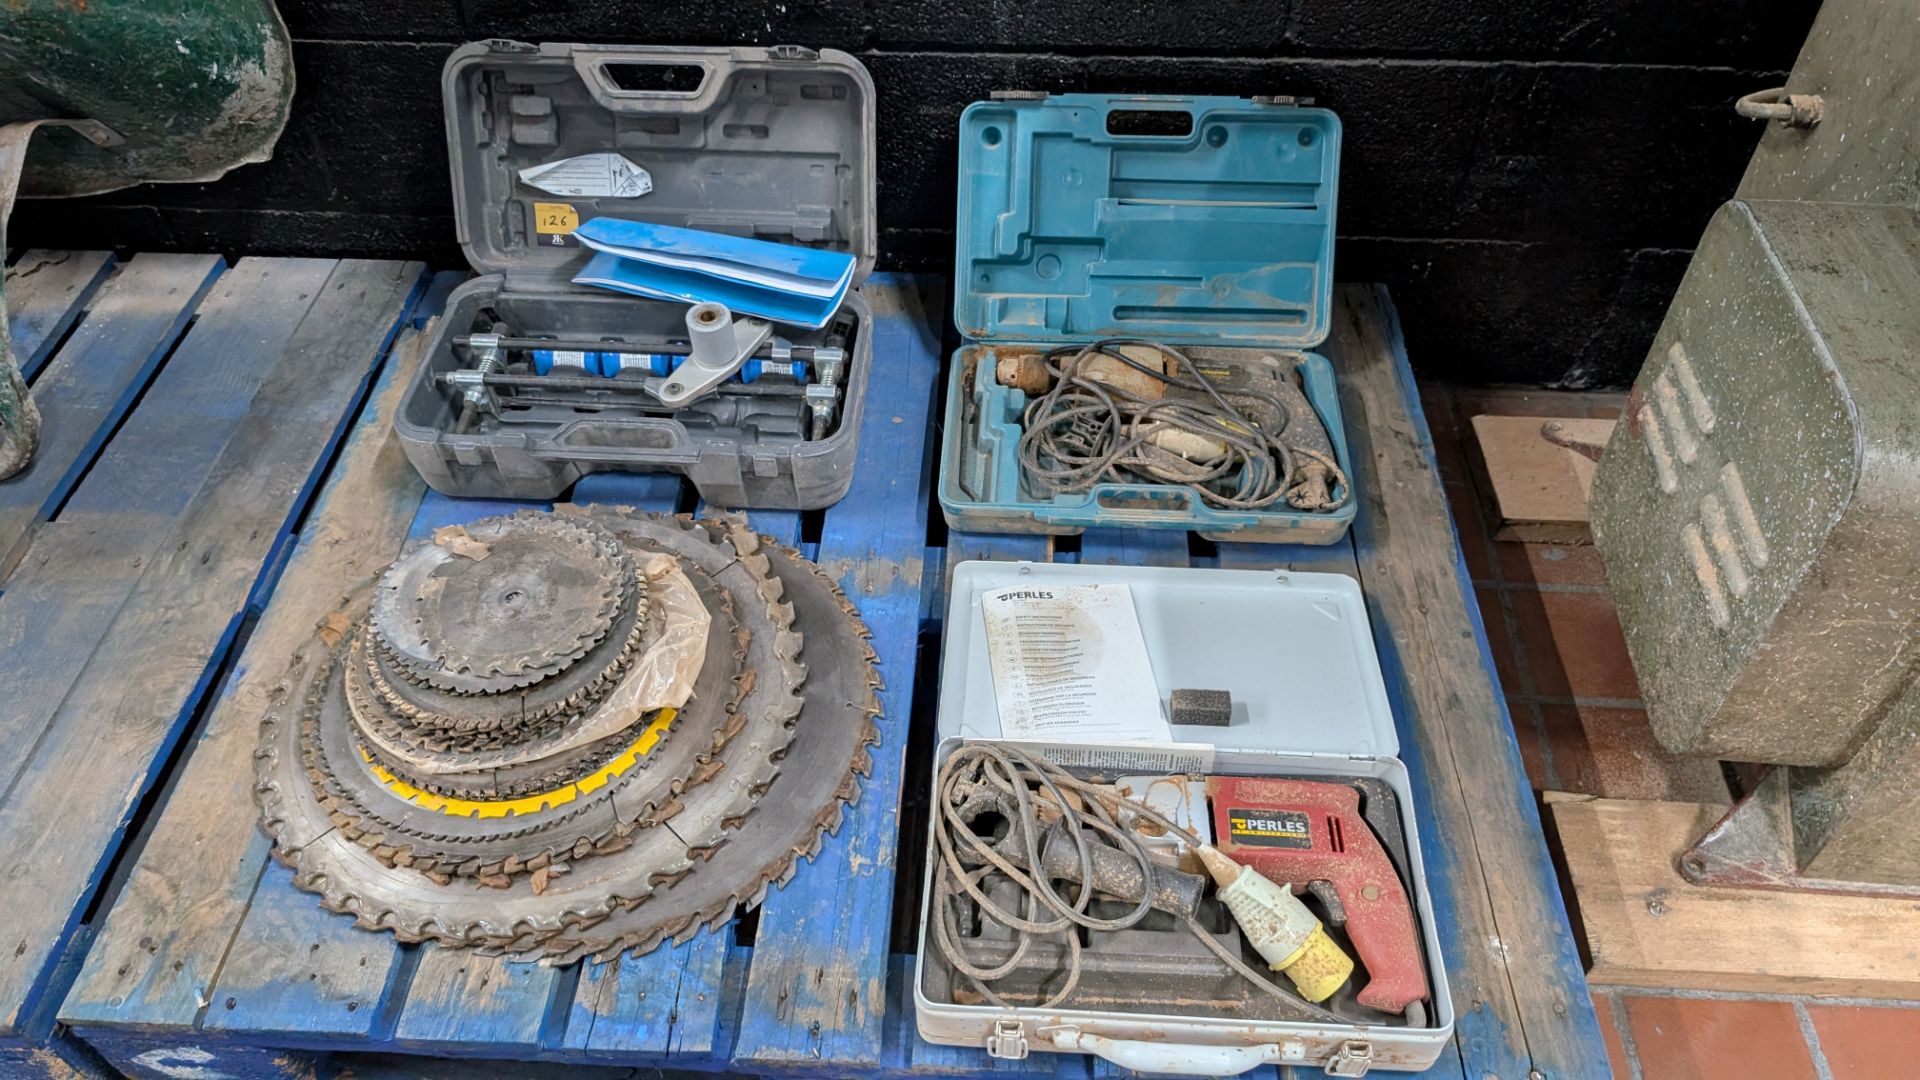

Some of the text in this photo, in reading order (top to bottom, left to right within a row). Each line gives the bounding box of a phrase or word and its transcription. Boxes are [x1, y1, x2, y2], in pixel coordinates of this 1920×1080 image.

[543, 215, 567, 227] 126
[1009, 591, 1054, 600] PERLES
[1247, 819, 1306, 833] PERLES
